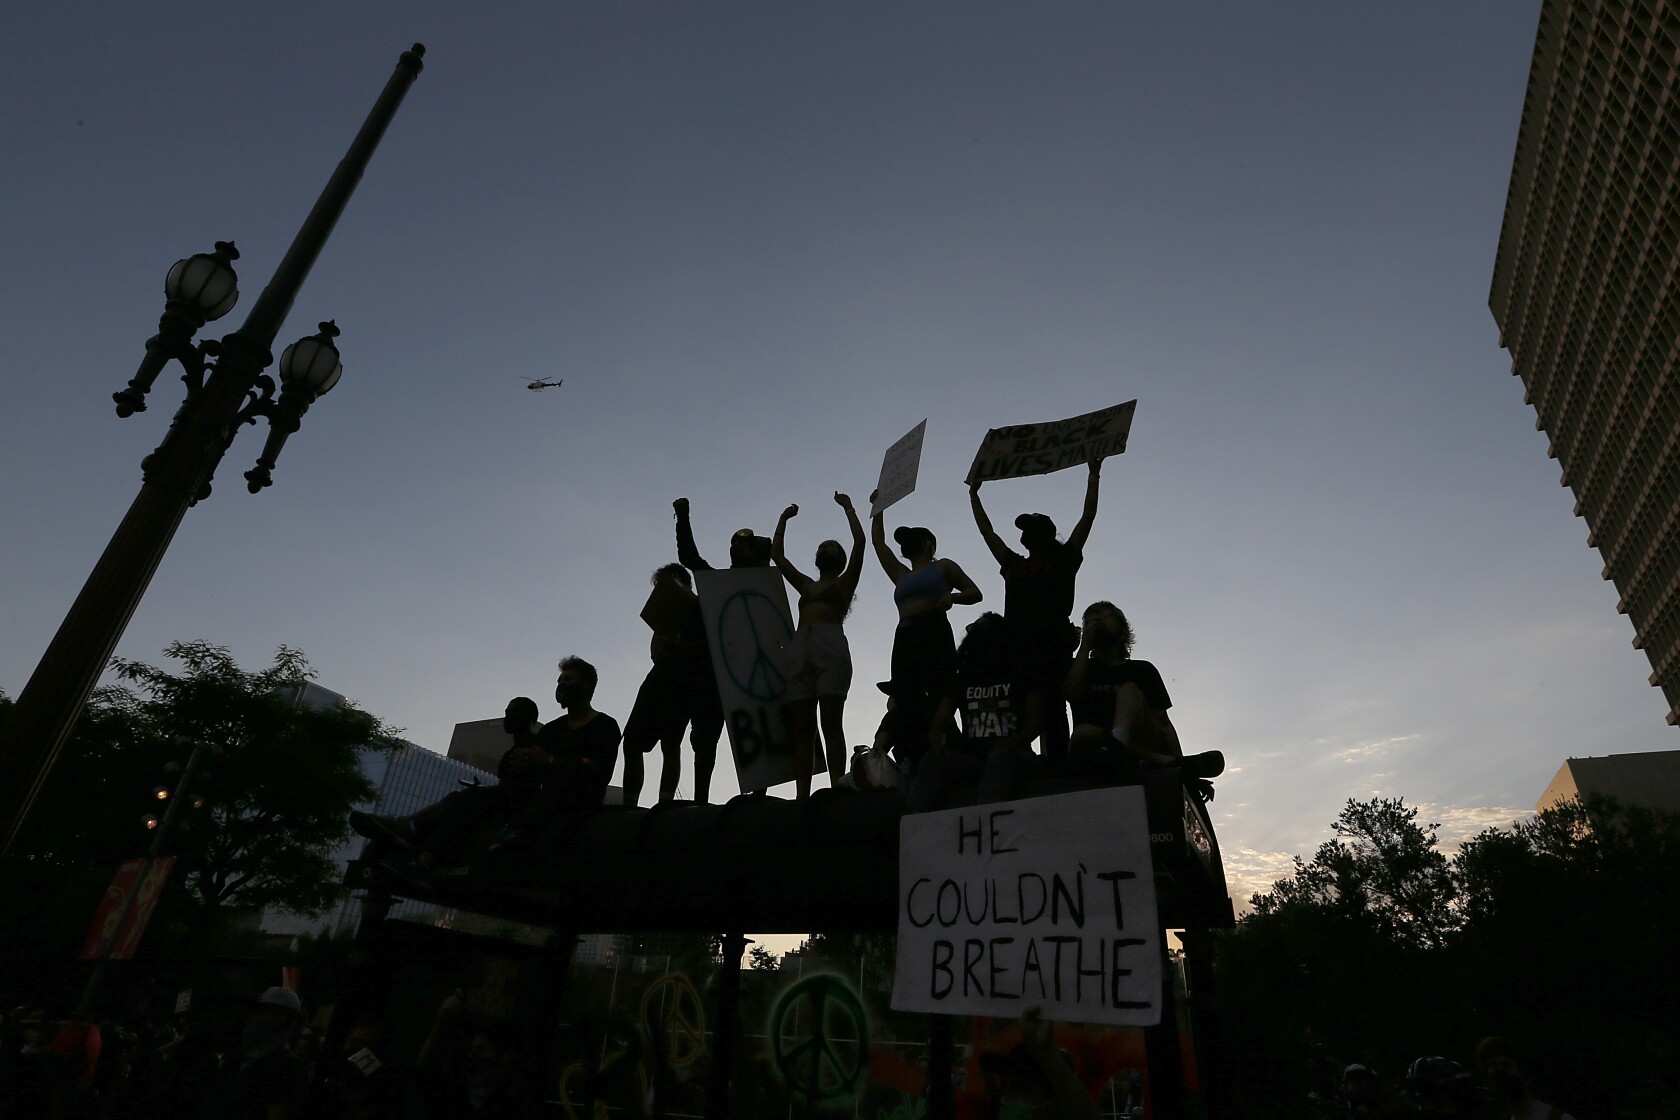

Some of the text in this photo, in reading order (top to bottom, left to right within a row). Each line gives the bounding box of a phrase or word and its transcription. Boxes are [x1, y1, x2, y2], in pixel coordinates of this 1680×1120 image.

[989, 403, 1134, 442] NO LIVES MATTER
[1012, 418, 1112, 455] BLACK
[975, 431, 1127, 480] LIVES MATTER
[966, 683, 1011, 700] EQUITY
[958, 809, 1018, 855] HE
[1151, 832, 1173, 843] 800
[907, 863, 1136, 930] COULDN'T
[931, 937, 1152, 1009] BREATHE
